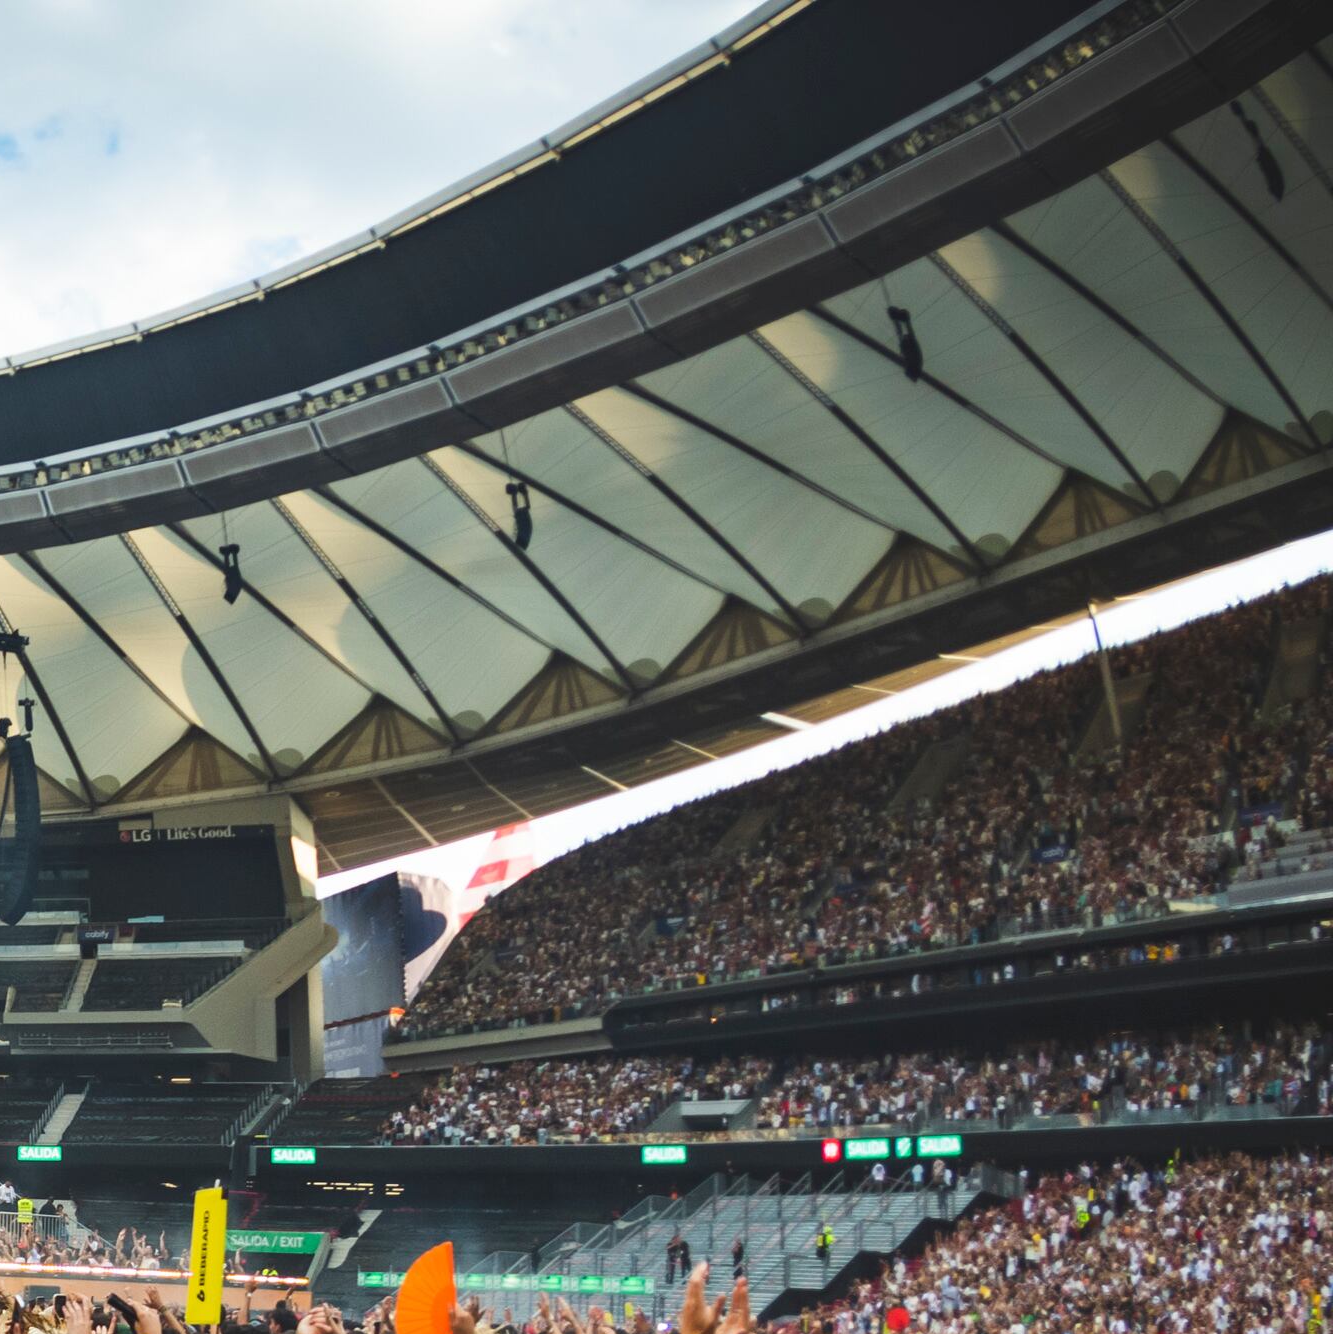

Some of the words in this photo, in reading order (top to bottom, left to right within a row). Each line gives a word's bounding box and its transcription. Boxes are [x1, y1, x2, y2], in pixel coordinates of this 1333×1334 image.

[132, 829, 152, 843] LG
[166, 827, 197, 841] Life's
[20, 1147, 60, 1159] SALIDA
[273, 1149, 314, 1162] SALIDA
[229, 1234, 270, 1248] SALIDA
[279, 1236, 305, 1248] EXIT
